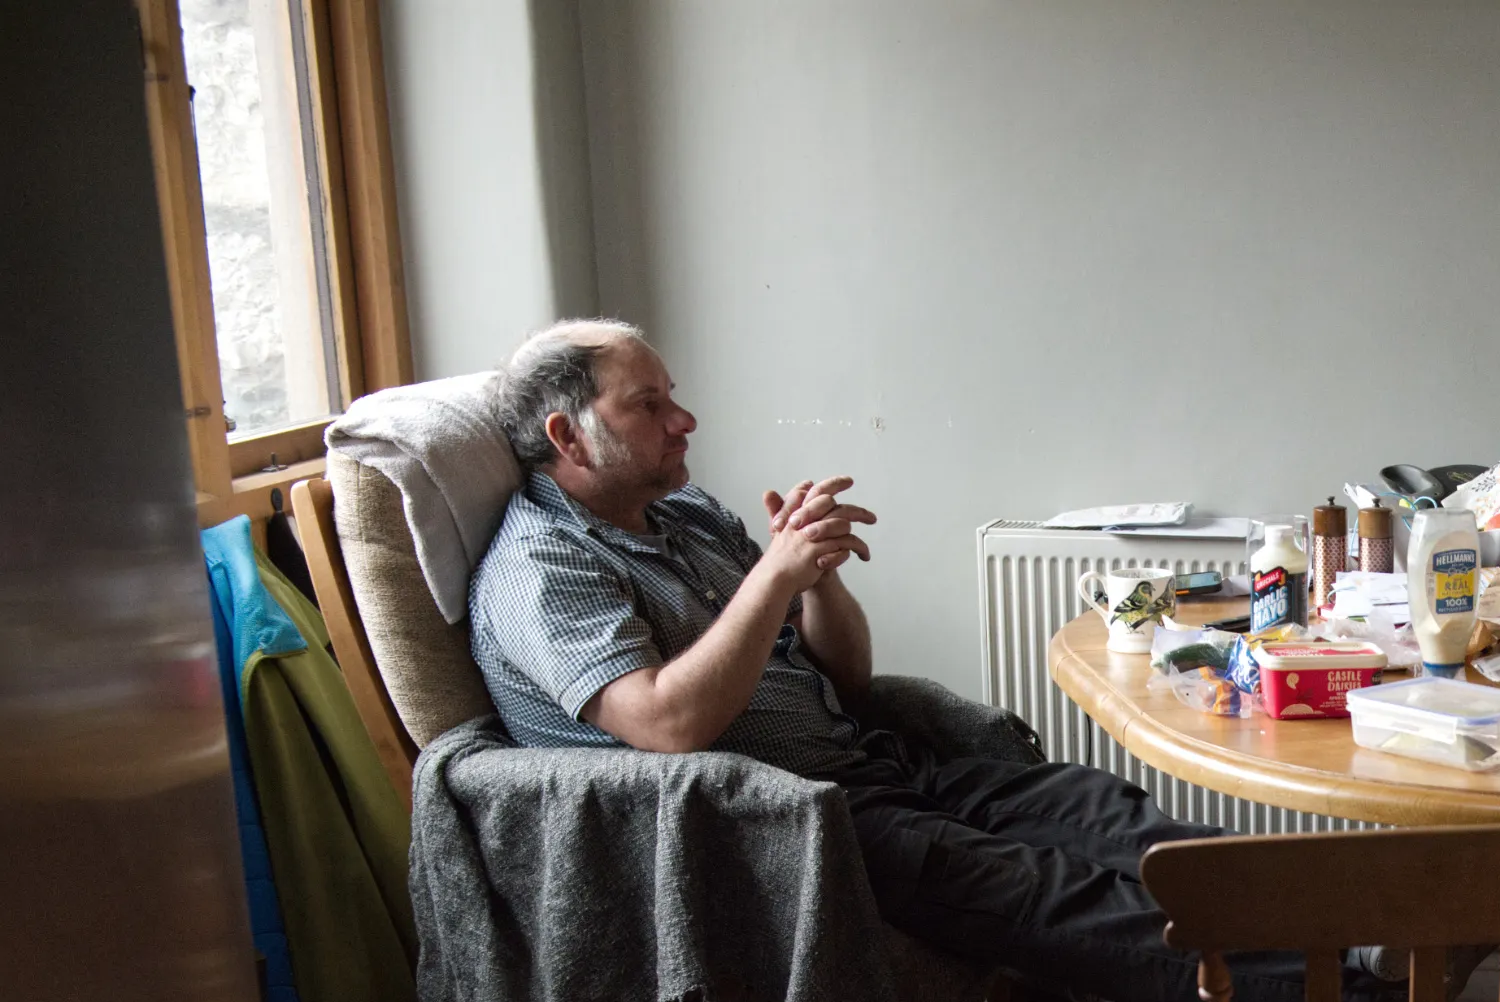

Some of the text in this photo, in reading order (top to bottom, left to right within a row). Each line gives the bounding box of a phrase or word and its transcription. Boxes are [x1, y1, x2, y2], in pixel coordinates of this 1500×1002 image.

[1256, 571, 1279, 589] CRUCIALS
[1445, 580, 1469, 591] REAL
[1253, 585, 1287, 614] GARLIC
[1445, 598, 1468, 607] 100%
[1253, 599, 1287, 630] MAYO
[1327, 671, 1361, 682] CASTLE
